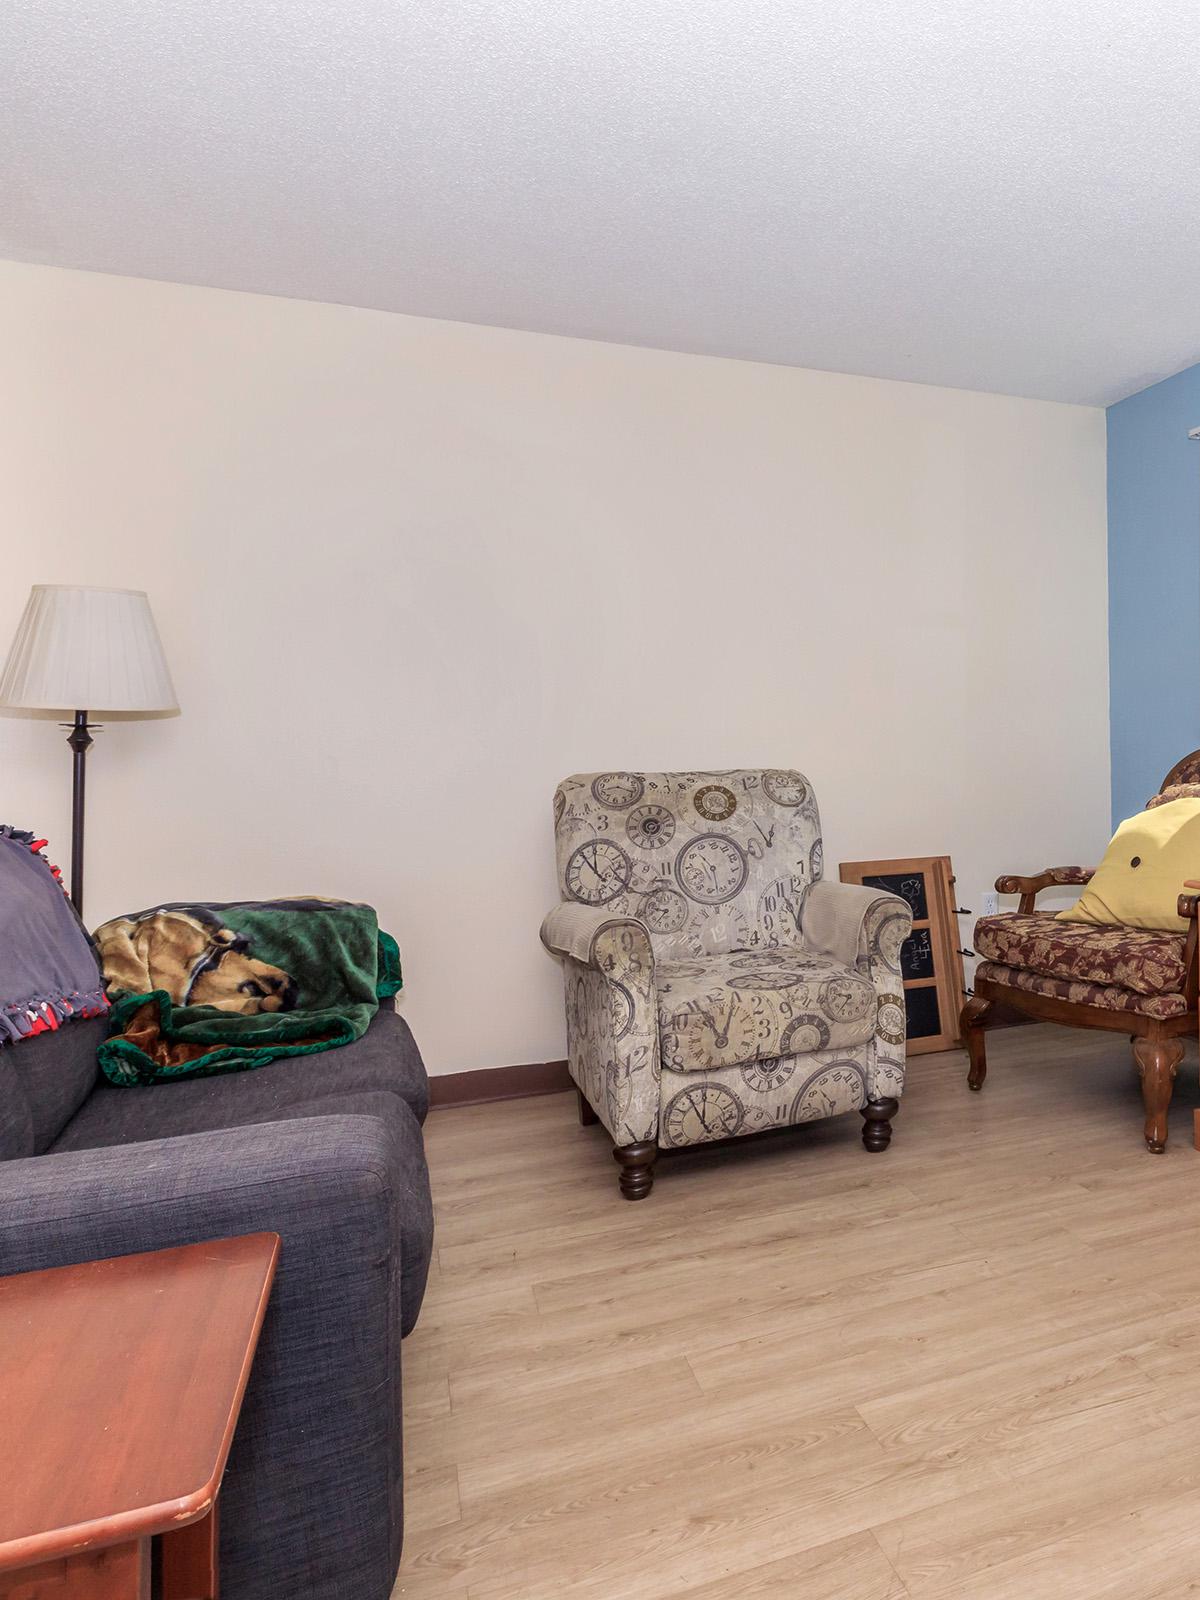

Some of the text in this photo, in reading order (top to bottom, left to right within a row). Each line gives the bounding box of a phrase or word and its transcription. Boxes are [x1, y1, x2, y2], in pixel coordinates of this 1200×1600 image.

[597, 815, 608, 831] 3
[764, 896, 776, 912] 10
[764, 915, 773, 931] 9
[621, 931, 633, 952] 9
[768, 932, 779, 948] 8
[603, 953, 617, 972] 4
[629, 953, 642, 972] 8
[751, 996, 764, 1015] 2
[780, 1002, 793, 1019] 9
[758, 1018, 771, 1039] 3
[625, 1046, 649, 1078] 12
